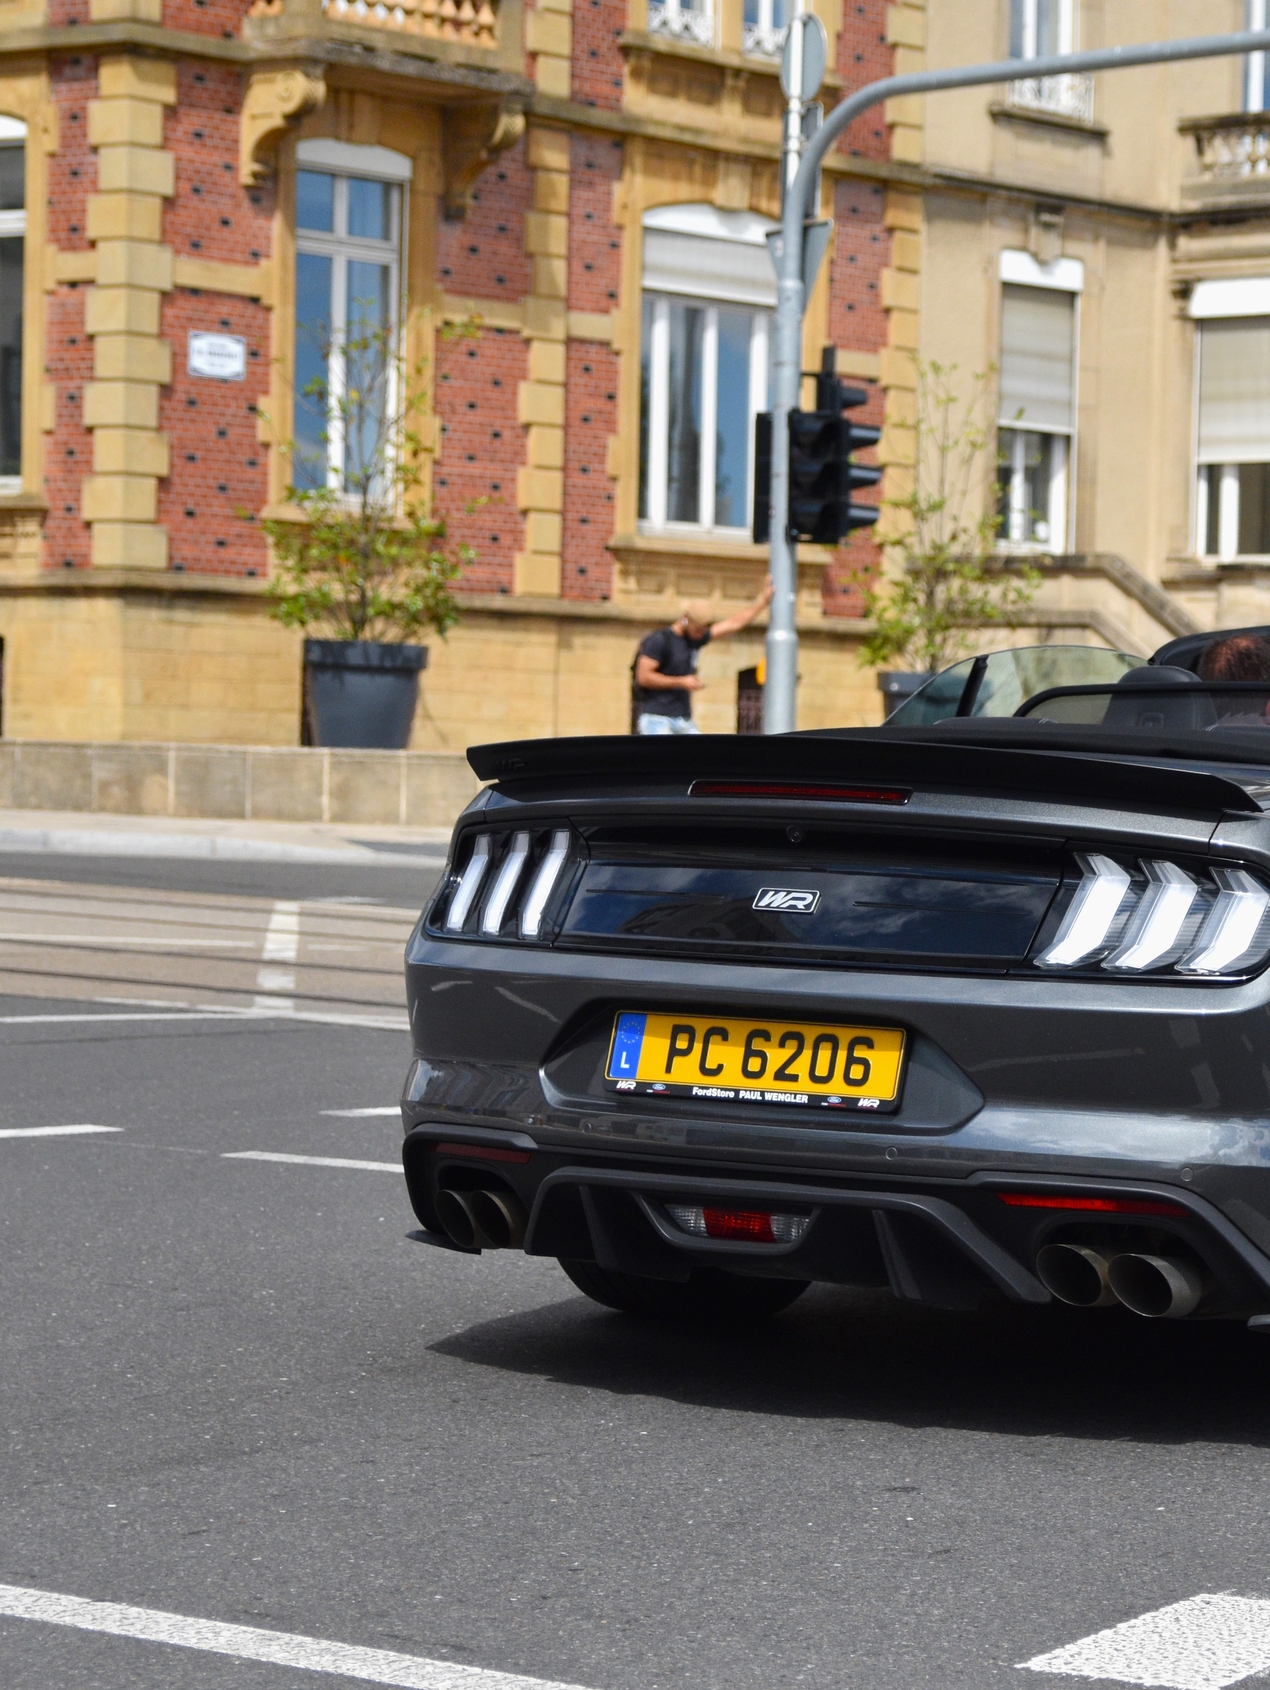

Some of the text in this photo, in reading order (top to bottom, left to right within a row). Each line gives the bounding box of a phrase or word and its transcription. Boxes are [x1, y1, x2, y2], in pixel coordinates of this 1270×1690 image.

[757, 890, 814, 909] WR
[620, 1051, 630, 1069] L
[665, 1024, 875, 1087] PC 6206
[616, 1080, 637, 1090] WR
[692, 1087, 735, 1098] FordStore
[739, 1090, 763, 1101] PAUL
[764, 1092, 809, 1104] WENGLER
[858, 1097, 880, 1108] WR
